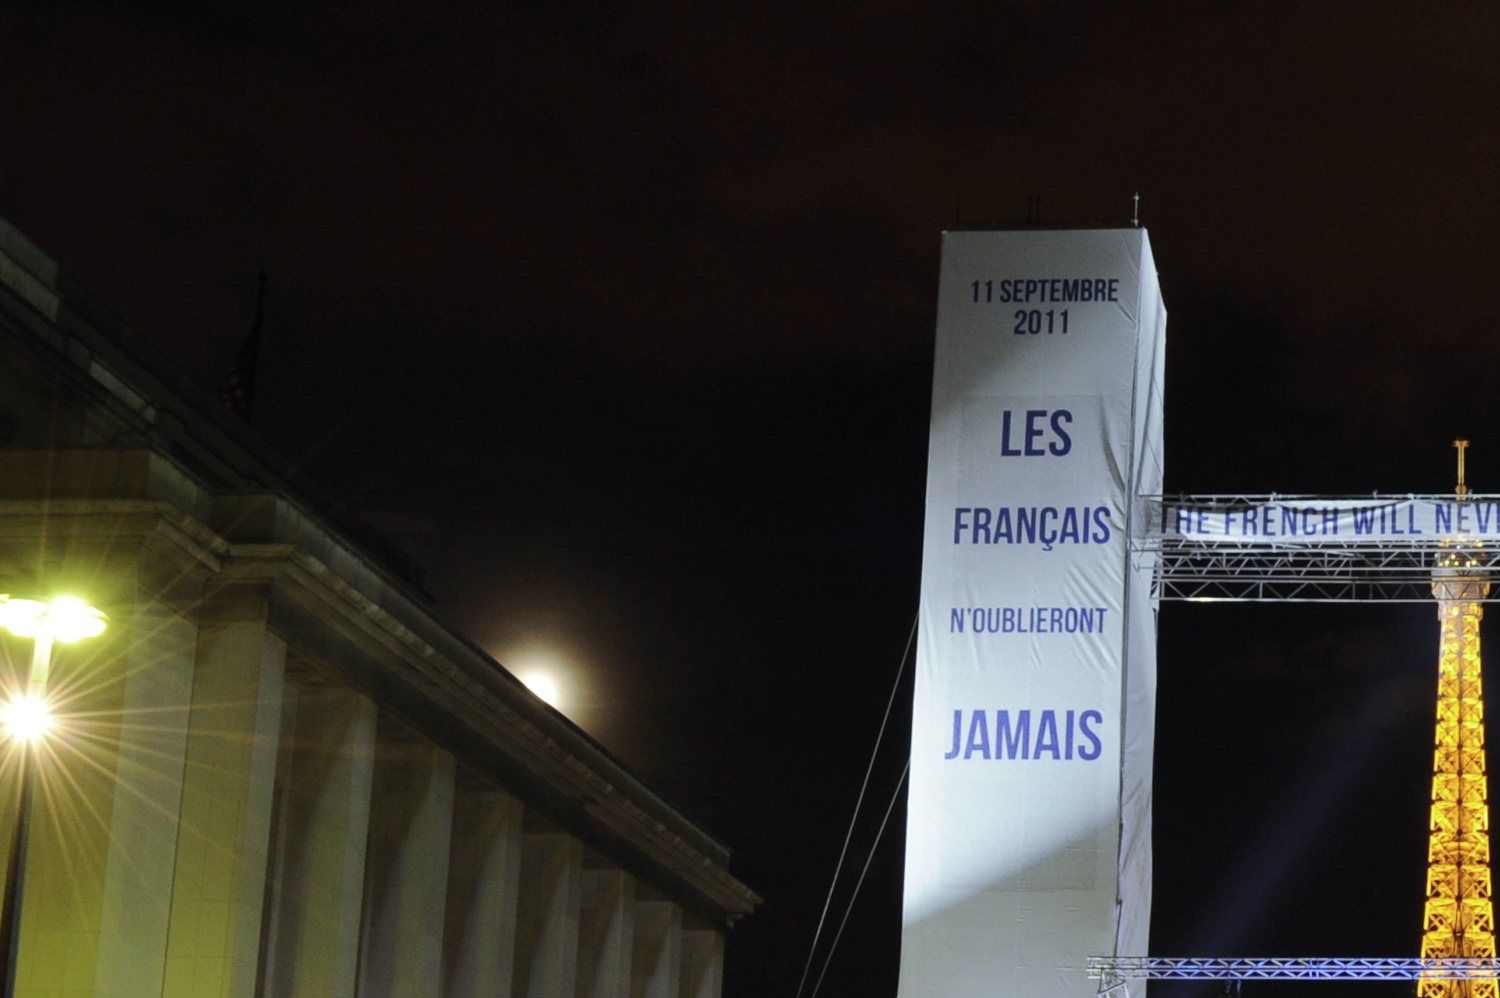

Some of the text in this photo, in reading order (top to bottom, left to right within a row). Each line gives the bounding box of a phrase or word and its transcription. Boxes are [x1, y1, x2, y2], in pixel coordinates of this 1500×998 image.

[971, 278, 1119, 303] 11 SEPTEMBRE
[1013, 309, 1069, 335] 2011
[1000, 408, 1073, 457] LES
[953, 506, 1112, 551] FRANÇAIS
[1225, 505, 1338, 536] FRENCH
[1352, 503, 1423, 535] WILL
[944, 709, 1103, 762] JAMAIS
